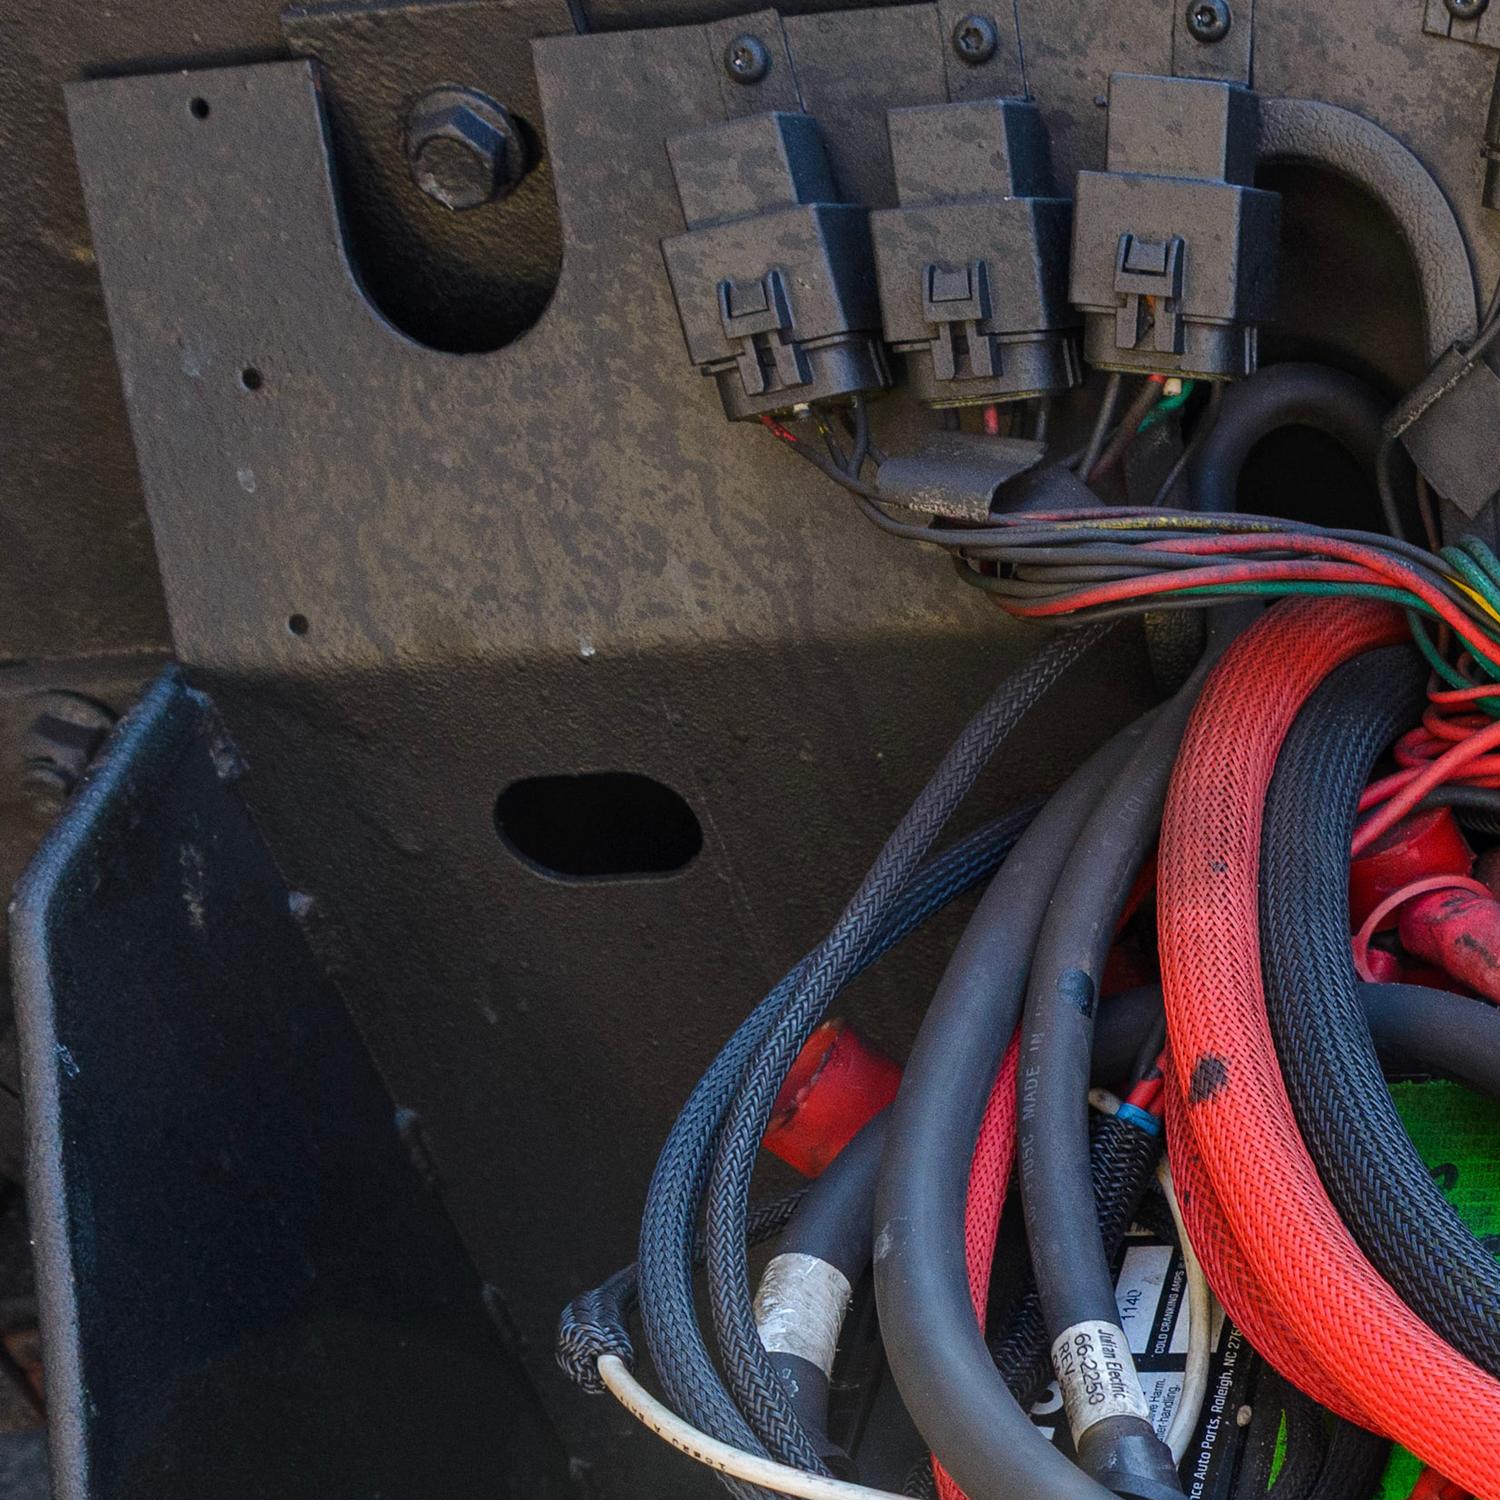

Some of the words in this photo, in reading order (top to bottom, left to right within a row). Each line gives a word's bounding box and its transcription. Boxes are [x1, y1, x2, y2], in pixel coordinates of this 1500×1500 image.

[1022, 1063, 1042, 1122] MADE
[1171, 1269, 1185, 1292] AMPS
[1120, 1288, 1143, 1321] 1140
[1161, 1293, 1179, 1334] CRANKING
[1154, 1332, 1169, 1355] COLD
[1223, 1350, 1238, 1368] NC
[1096, 1328, 1117, 1361] Julian
[1107, 1361, 1127, 1400] Electric
[1211, 1367, 1234, 1415] Raleigh,
[1201, 1414, 1222, 1451] Parts,
[1193, 1450, 1211, 1480] Auto
